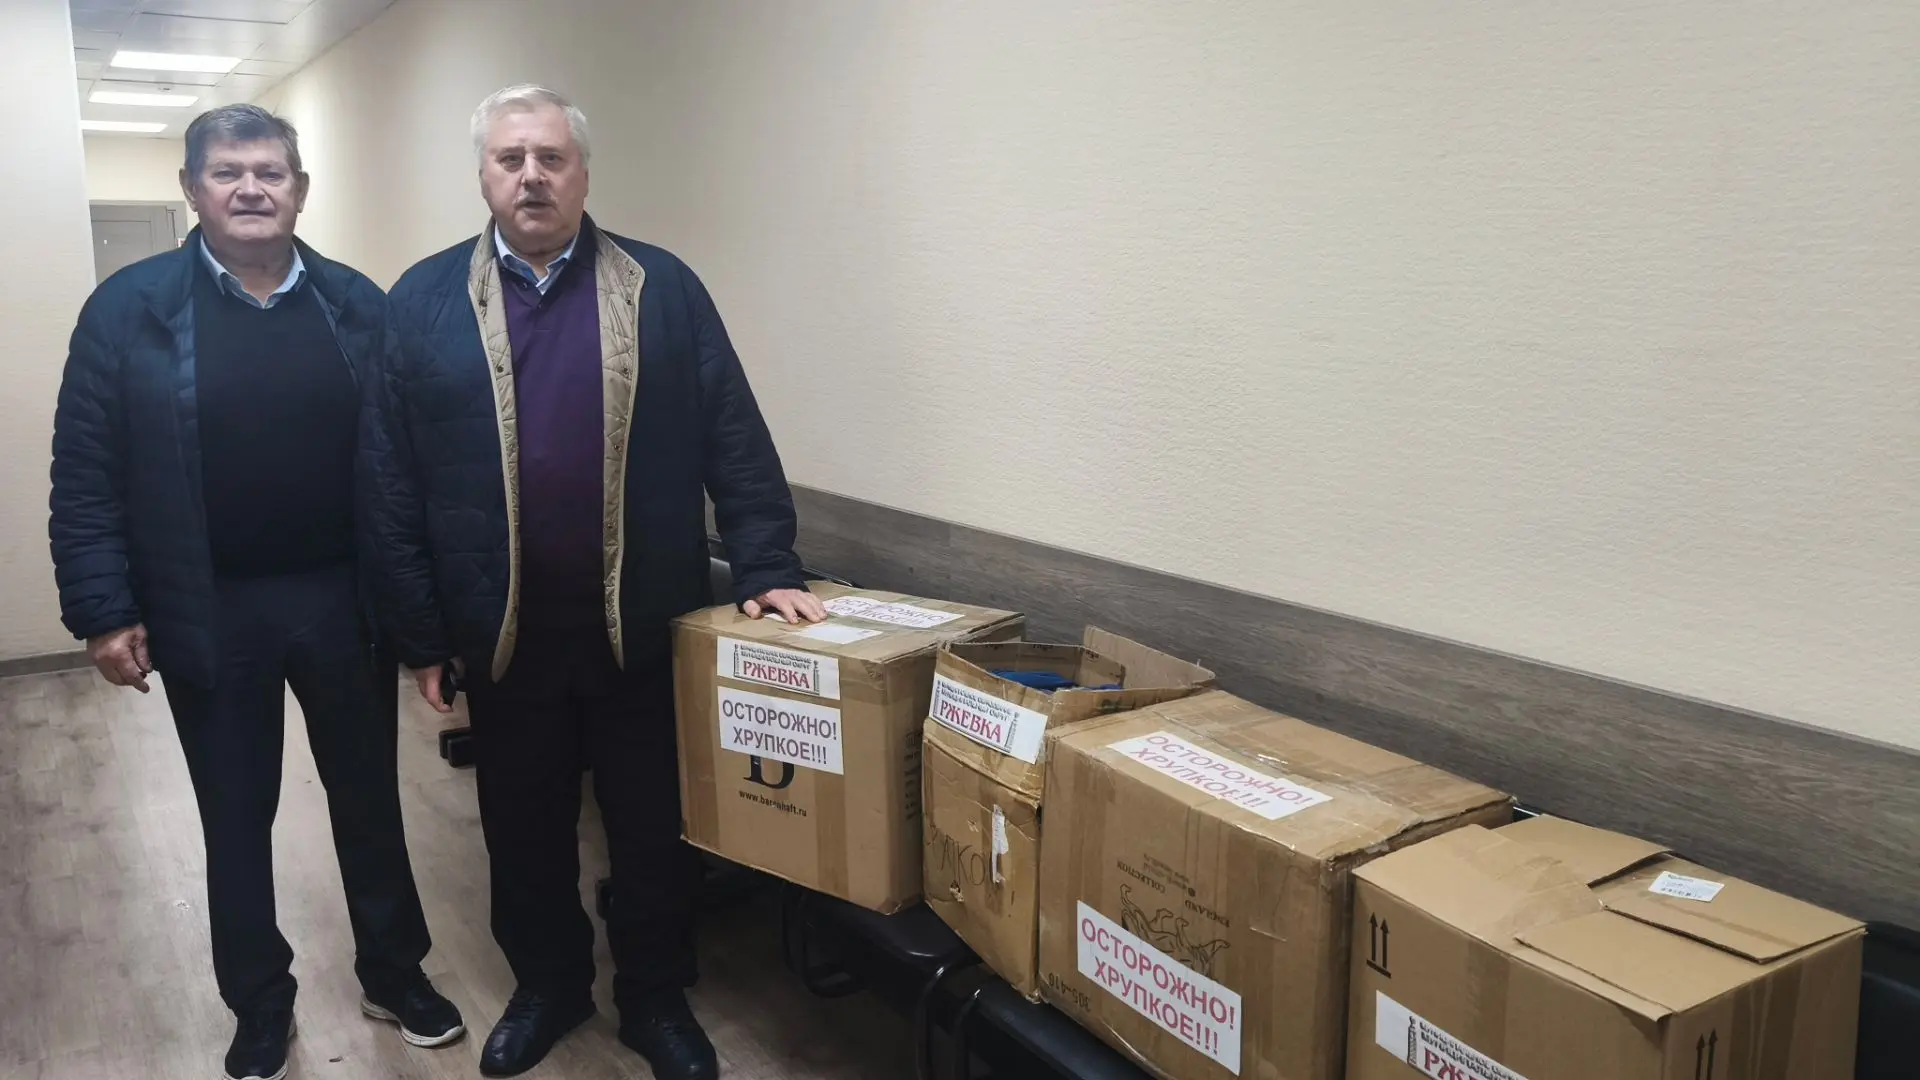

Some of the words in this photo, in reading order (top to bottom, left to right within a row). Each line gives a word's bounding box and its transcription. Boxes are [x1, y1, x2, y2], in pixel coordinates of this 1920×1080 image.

[743, 660, 810, 689] РЖЕВКА
[722, 699, 837, 741] ОСТОРОЖНО!
[940, 699, 1001, 743] РЖЕВКА
[732, 726, 827, 765] ХРУПКОЕ!!!
[1130, 747, 1269, 808] ХРУПКОЕ!!!
[1146, 735, 1313, 805] ОСТОРОЖНО!
[1081, 918, 1235, 1030] ОСТОРОЖНО!
[1094, 955, 1218, 1055] ХРУПКОЕ!!!
[1424, 1047, 1479, 1080] РЖ
